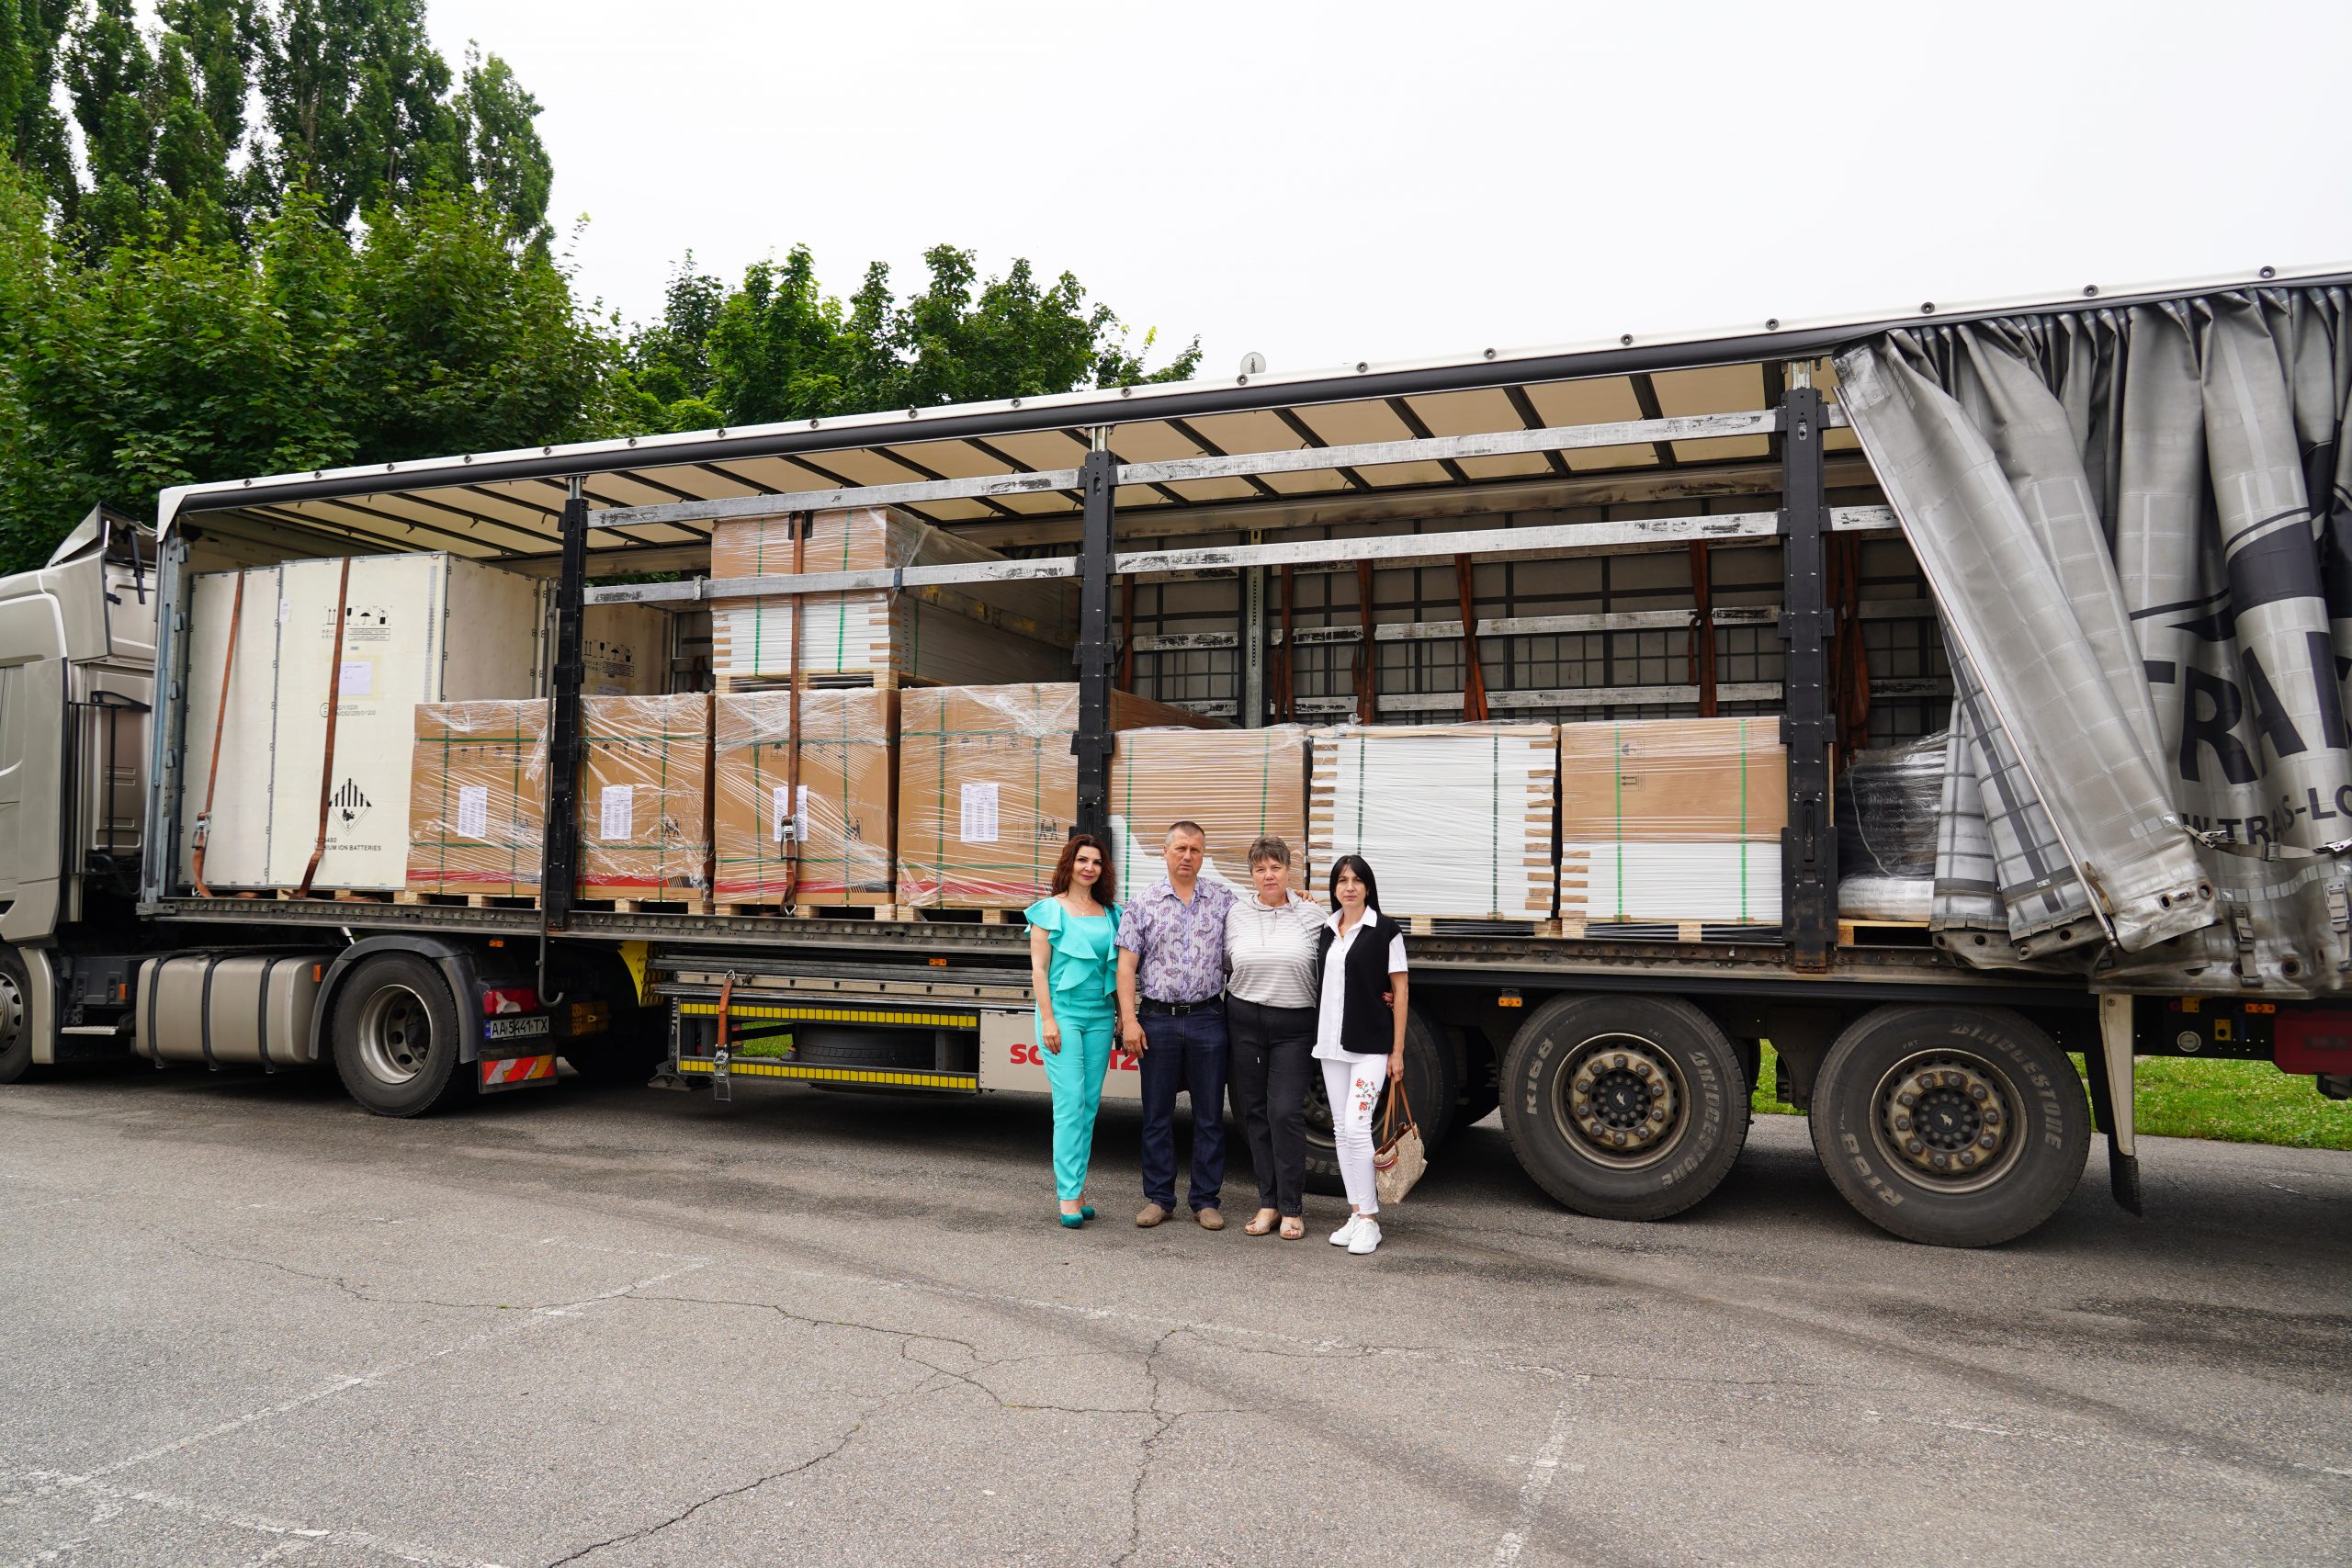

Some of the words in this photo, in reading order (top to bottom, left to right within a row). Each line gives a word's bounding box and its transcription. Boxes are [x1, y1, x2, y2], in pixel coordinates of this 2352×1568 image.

[492, 1022, 506, 1036] AA
[509, 1020, 531, 1034] 5441
[534, 1018, 548, 1032] TX
[1011, 1043, 1138, 1071] SCTZ
[1661, 1050, 1721, 1190] BRIDGESTONE
[1949, 1021, 2064, 1150] BRIDGESTONE
